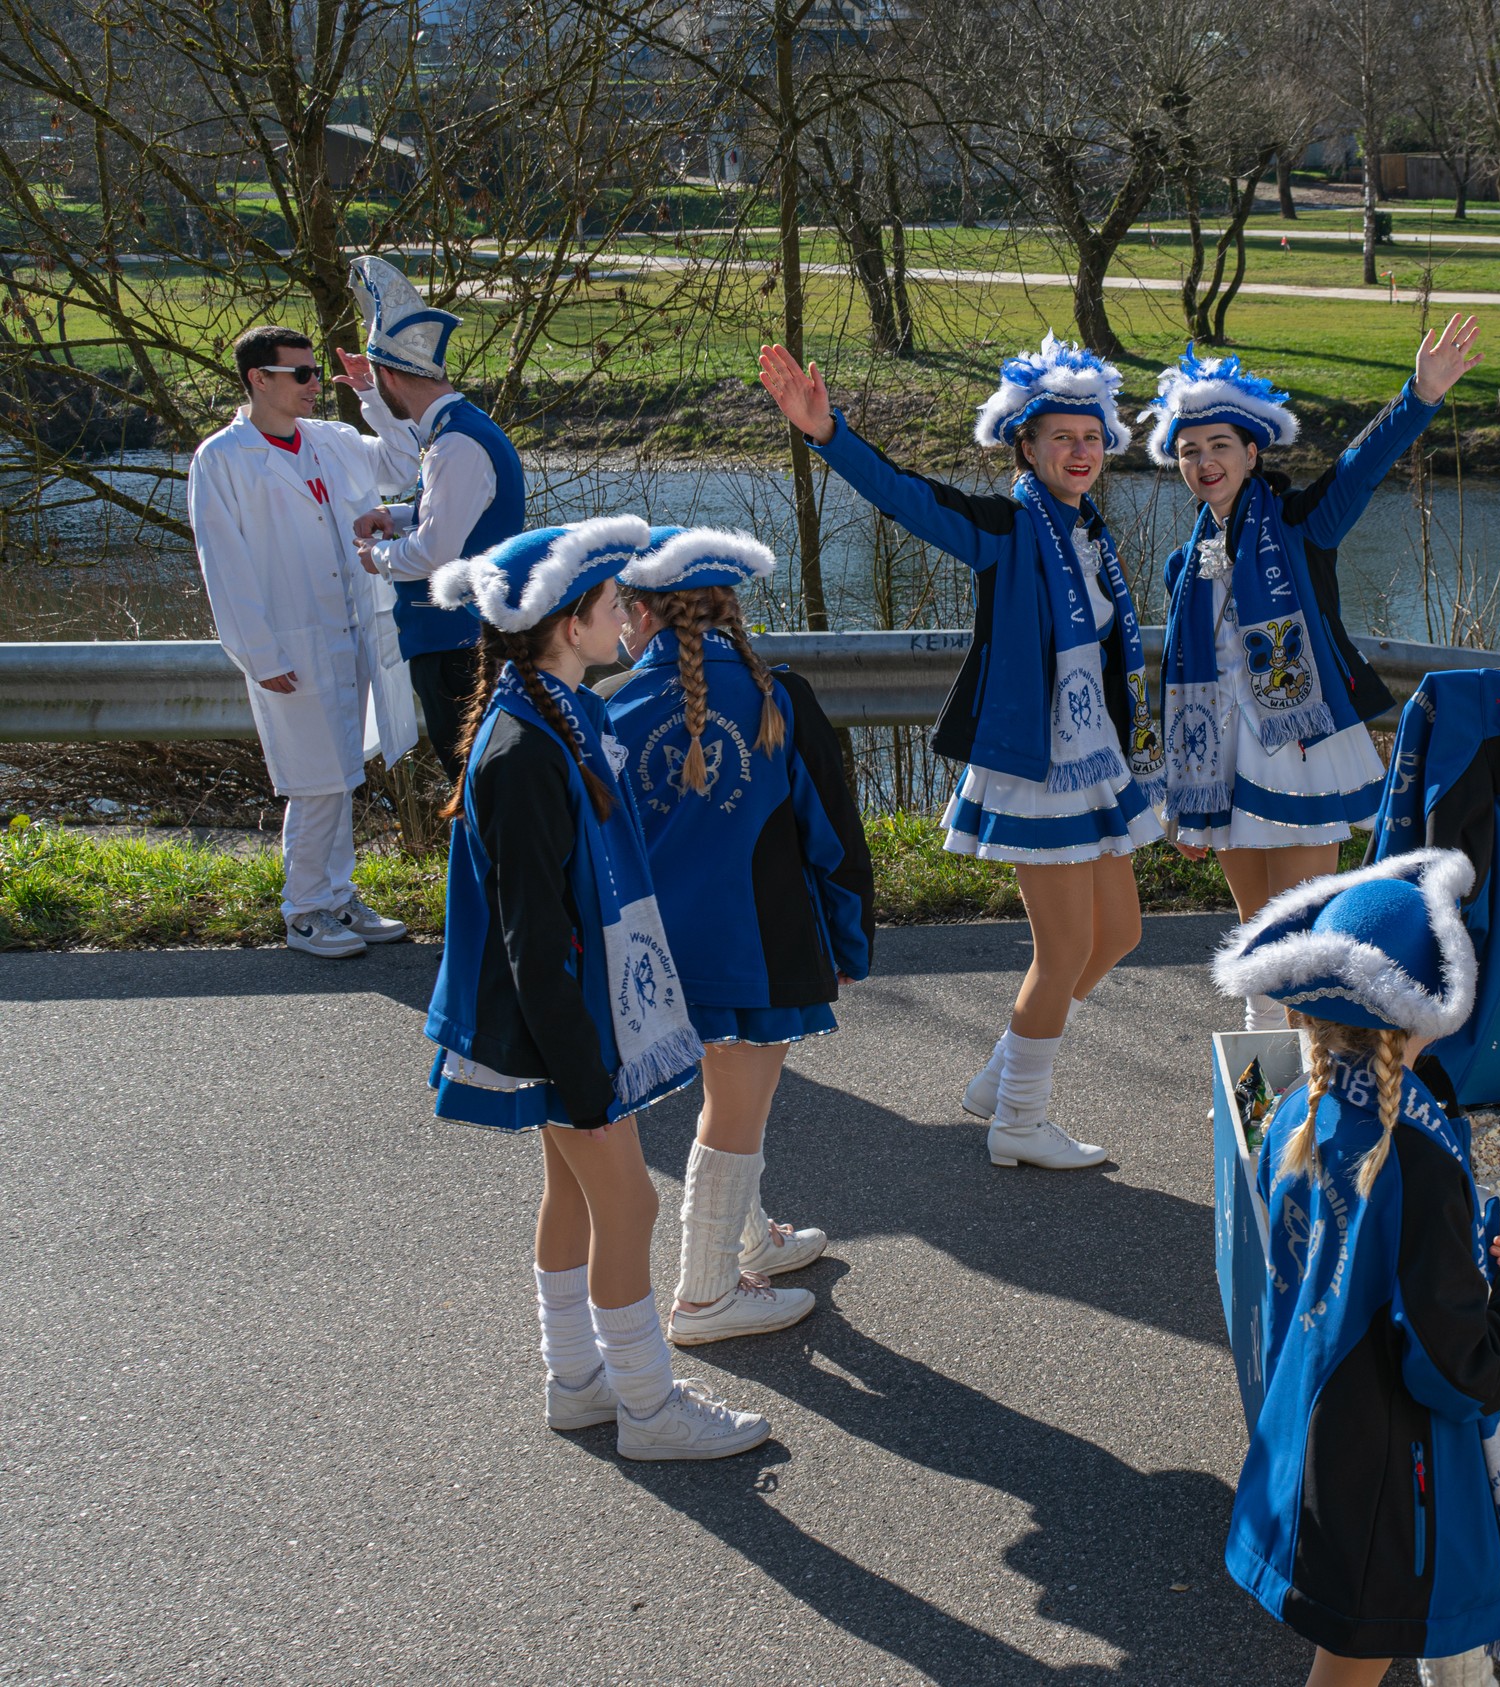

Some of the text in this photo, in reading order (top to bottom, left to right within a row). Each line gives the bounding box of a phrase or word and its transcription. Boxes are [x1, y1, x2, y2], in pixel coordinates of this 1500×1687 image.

[1265, 565, 1292, 602] e.V.
[1068, 589, 1085, 628] e.V.
[1058, 729, 1073, 743] KV
[1195, 703, 1221, 745] Wallendorf
[706, 708, 753, 783] Wallendorf
[647, 797, 672, 815] KV
[720, 788, 743, 814] e.V.
[629, 931, 677, 979] Wallendorf
[1266, 1263, 1290, 1295] KV
[1299, 1300, 1327, 1333] e.V.
